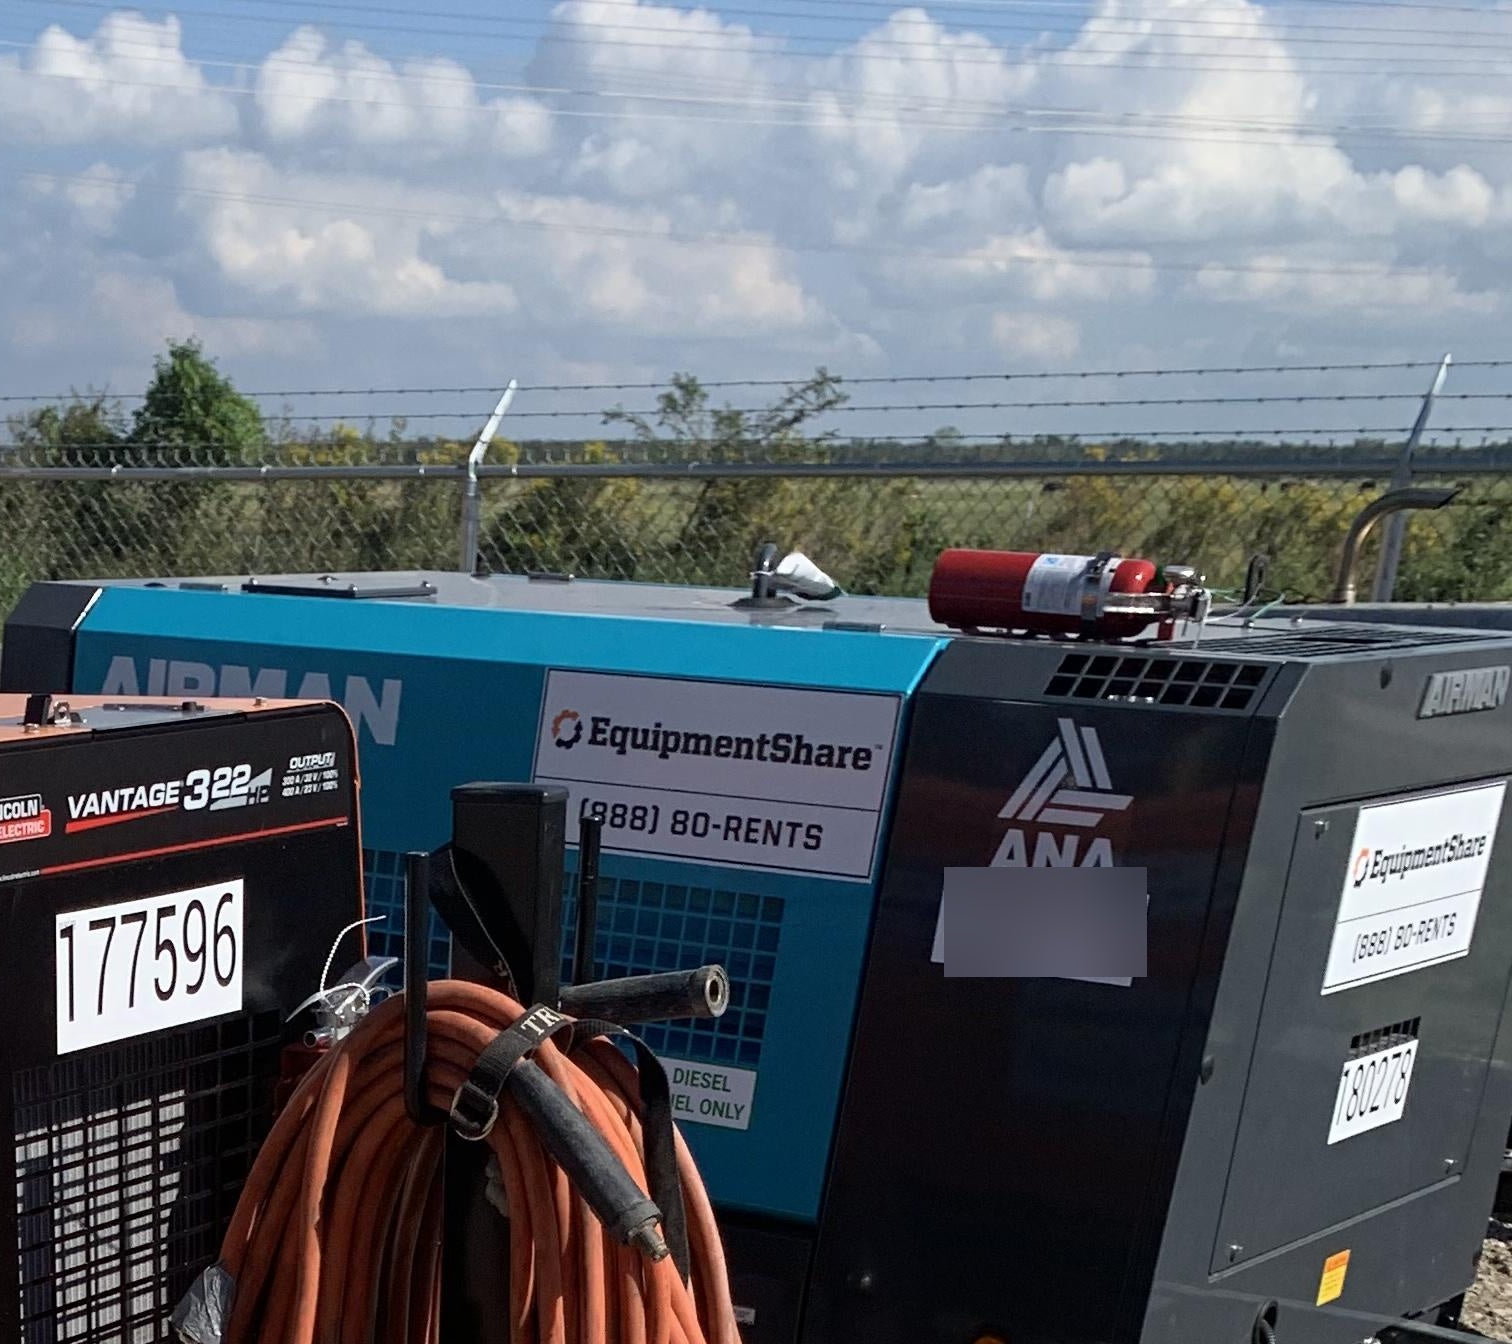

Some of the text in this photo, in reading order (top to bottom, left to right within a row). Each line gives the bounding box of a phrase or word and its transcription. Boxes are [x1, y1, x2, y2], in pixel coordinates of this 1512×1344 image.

[1419, 666, 1510, 718] AIRMAN
[289, 752, 335, 769] OUTPUT
[588, 716, 873, 771] EquipmentShare
[67, 781, 181, 819] VANTAGE
[580, 797, 824, 850] (888) 80-RENTS
[989, 828, 1114, 867] ANA
[1369, 834, 1487, 883] EquipmentShare
[60, 893, 236, 1022] 177596
[1352, 912, 1457, 963] (888) 80-RENTS
[520, 1006, 564, 1036] TR
[673, 1068, 731, 1093] DIESEL
[1336, 1048, 1412, 1126] 180278
[700, 1098, 745, 1121] ONLY
